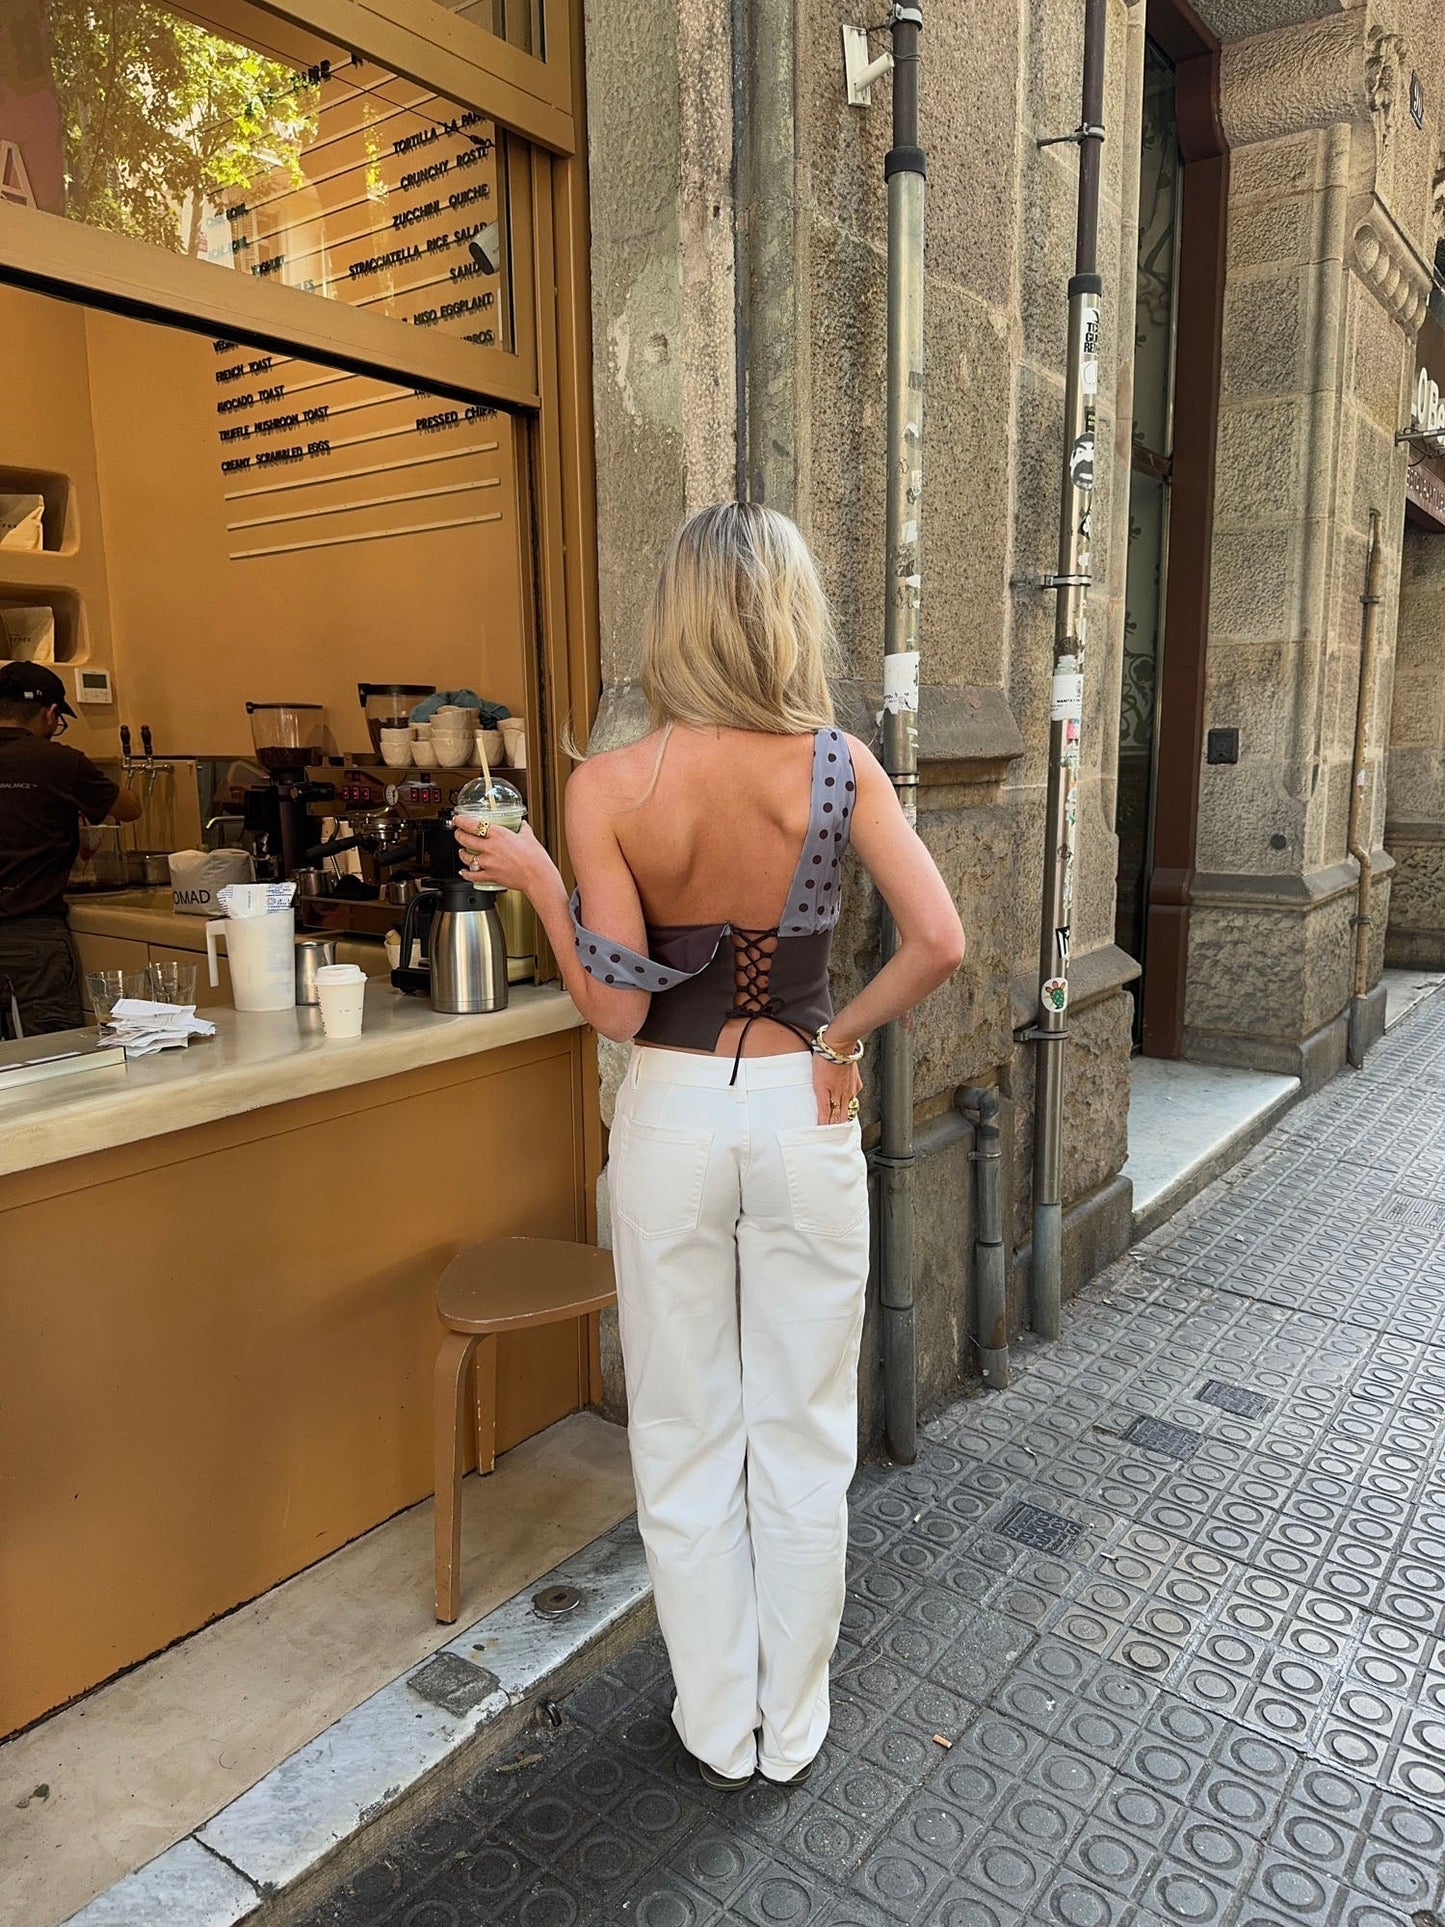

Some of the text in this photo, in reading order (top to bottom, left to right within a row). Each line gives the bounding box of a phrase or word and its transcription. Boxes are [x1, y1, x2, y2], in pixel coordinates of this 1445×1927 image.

[392, 127, 438, 153] TORTILLA
[400, 160, 449, 188] CRUNCHY
[392, 183, 490, 227] ZUCCHINI QUICHE
[348, 245, 421, 277] STRACCIATELLA
[426, 235, 449, 251] RICE
[440, 292, 493, 318] EGGPLANT
[215, 357, 272, 382] FRENCH TOAST
[217, 385, 285, 413] AVOCADO TOAST
[218, 405, 329, 441] TRUFFLE MUSHROOM TOAST
[416, 411, 459, 430] PRESSED
[221, 440, 330, 471] CREAMY SCRAMBLED EGGS
